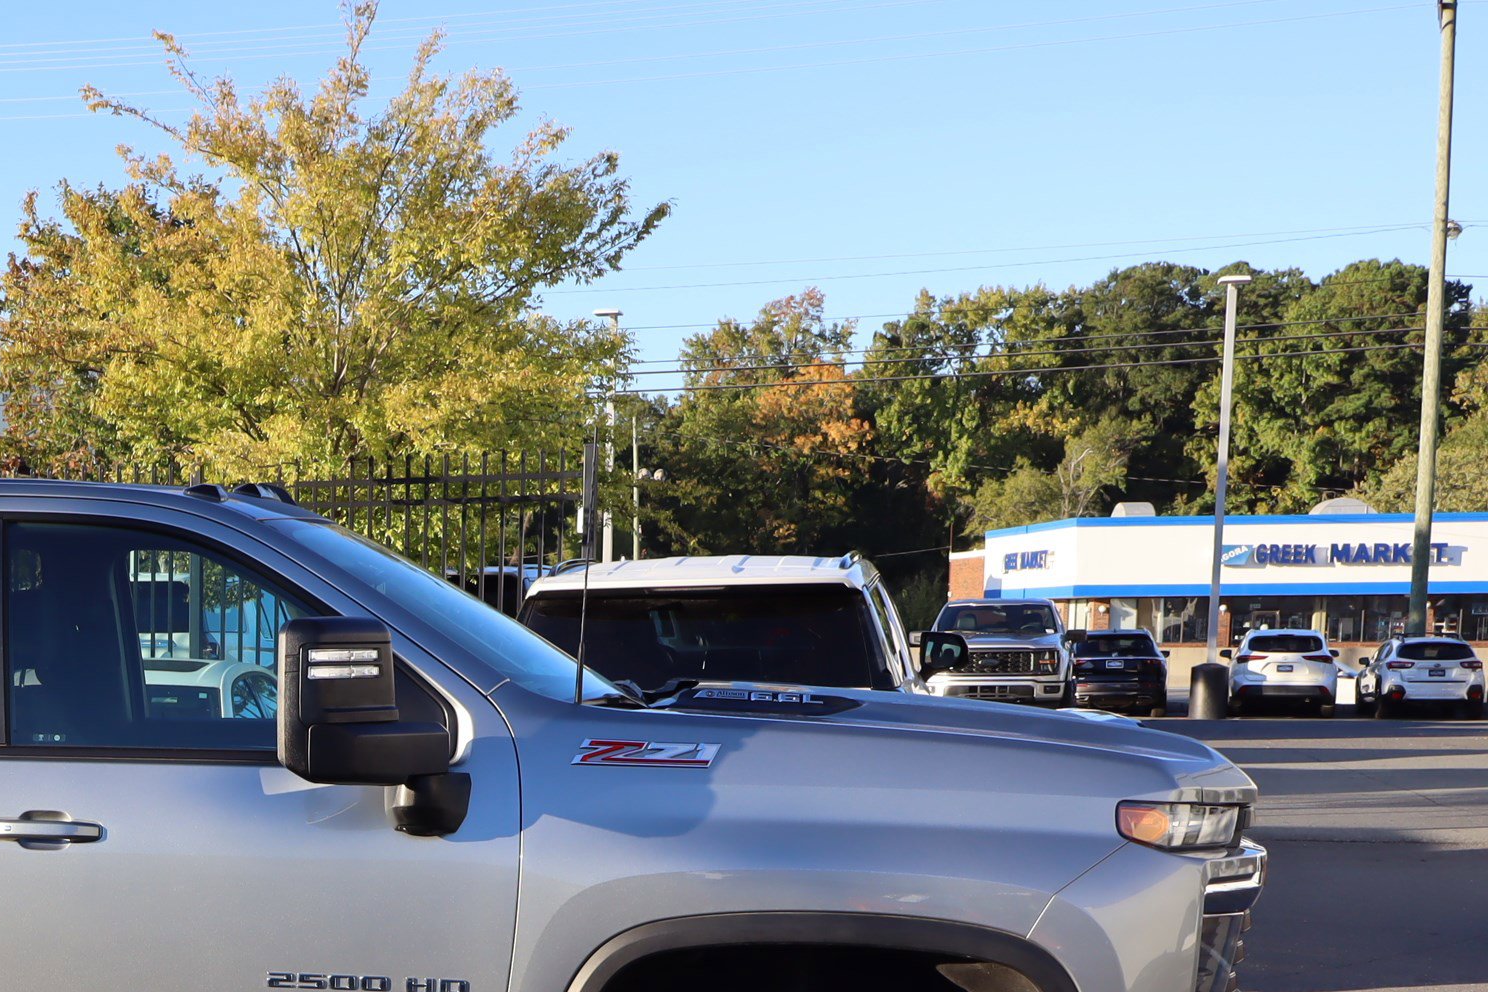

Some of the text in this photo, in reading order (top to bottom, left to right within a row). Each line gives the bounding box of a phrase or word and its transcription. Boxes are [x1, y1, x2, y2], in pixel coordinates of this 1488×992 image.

[1221, 542, 1449, 564] GORA GREEK MARKT
[570, 737, 722, 769] Z71
[266, 971, 392, 992] 2500
